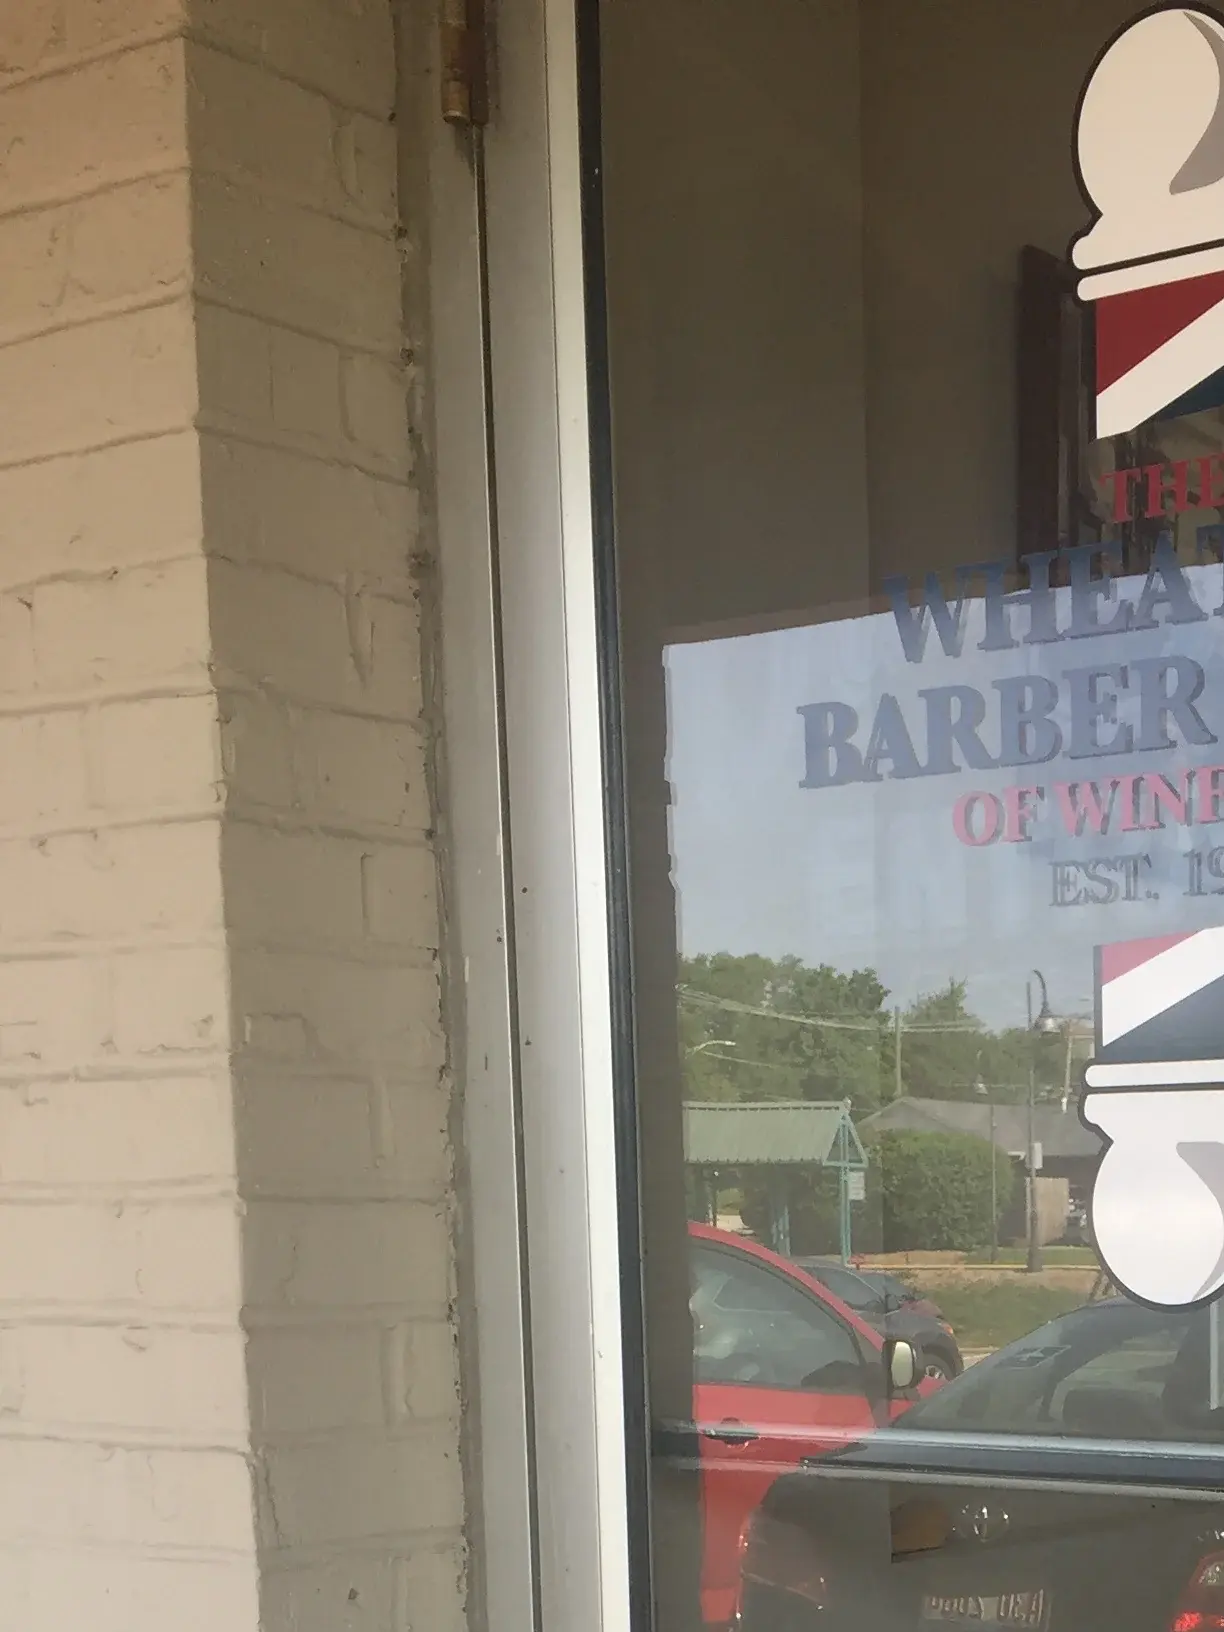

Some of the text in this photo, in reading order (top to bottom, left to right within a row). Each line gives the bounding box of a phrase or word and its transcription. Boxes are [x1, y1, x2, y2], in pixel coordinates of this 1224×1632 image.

[797, 653, 1217, 790] BARBER
[952, 788, 1044, 846] OF
[1050, 855, 1160, 907] EST.
